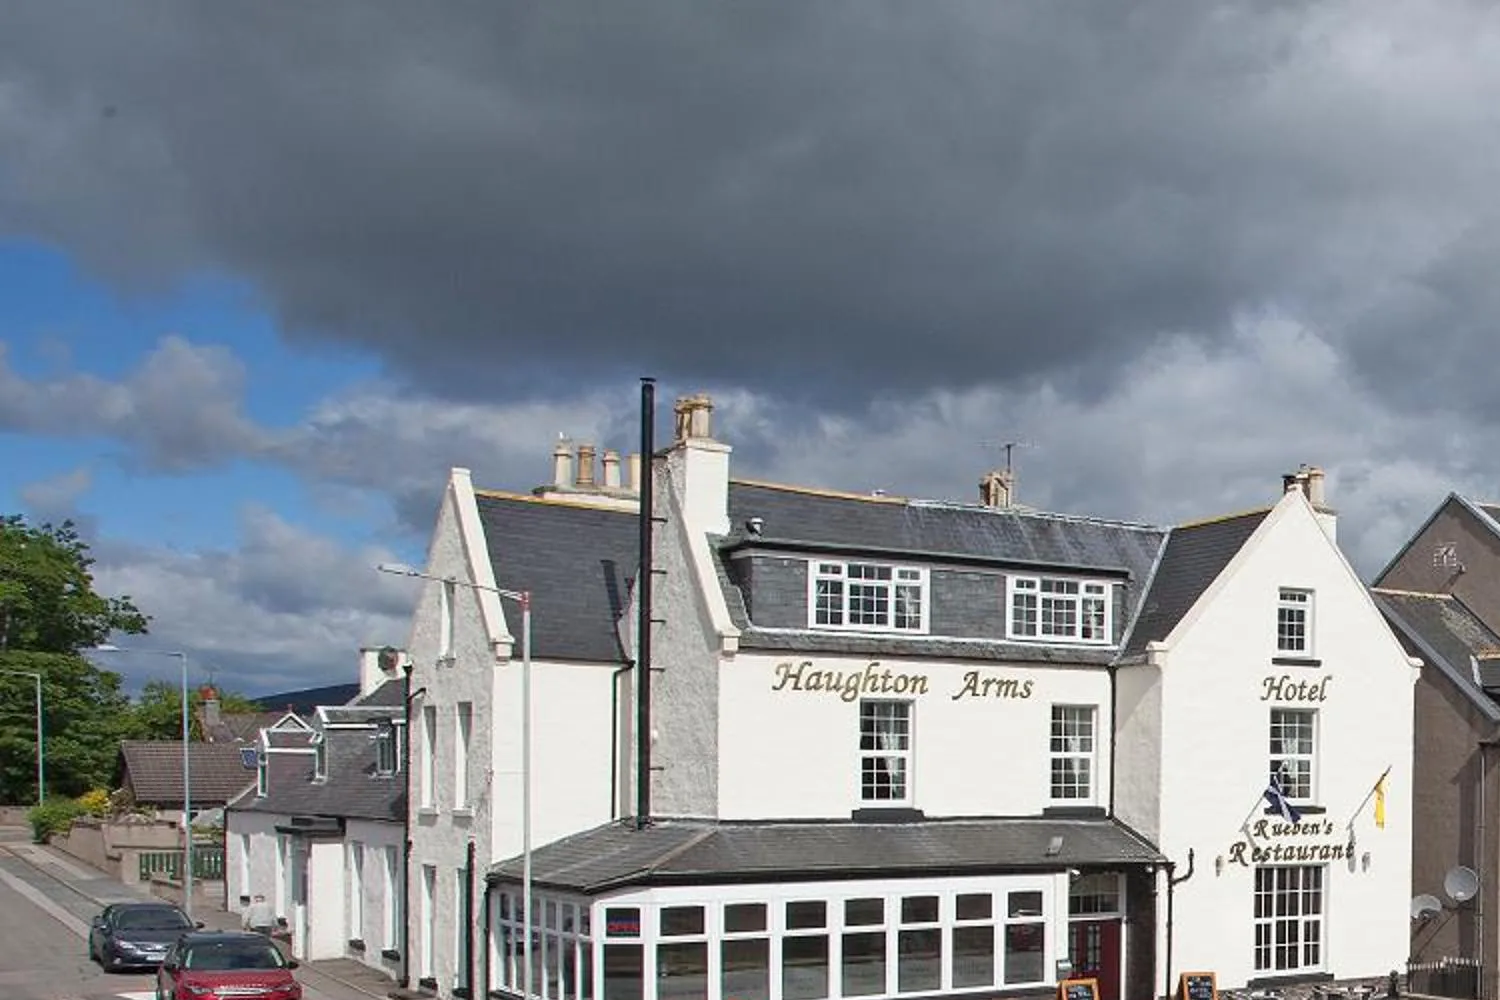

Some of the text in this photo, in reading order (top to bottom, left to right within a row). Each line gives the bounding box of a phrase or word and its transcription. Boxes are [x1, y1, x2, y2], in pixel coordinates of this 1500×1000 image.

[771, 661, 1035, 702] Haughton Arms
[1260, 675, 1333, 702] Hotel
[1229, 841, 1354, 867] Restaurant
